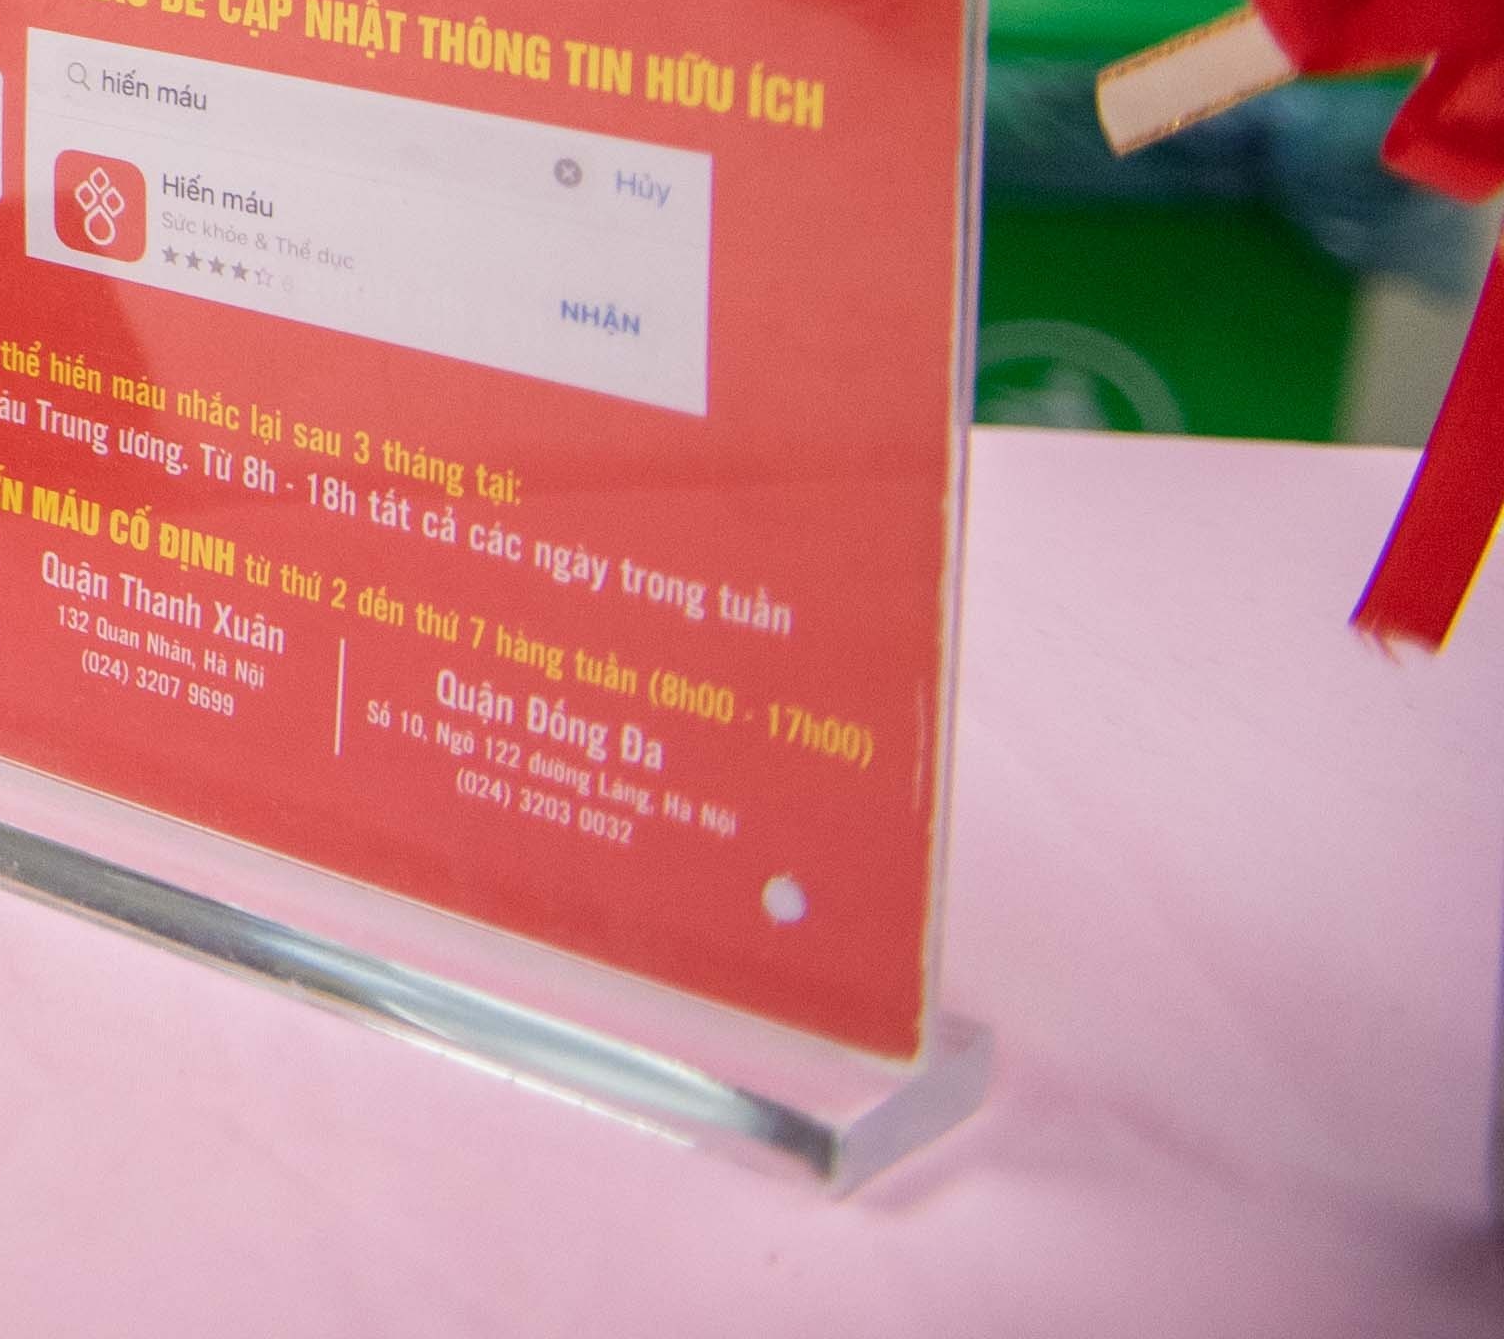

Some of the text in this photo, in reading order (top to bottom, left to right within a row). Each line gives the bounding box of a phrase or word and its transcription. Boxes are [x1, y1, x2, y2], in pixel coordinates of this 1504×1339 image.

[100, 68, 208, 113] hiến máu
[417, 14, 553, 82] THÔNG
[563, 38, 634, 97] TIN
[747, 60, 827, 131] ÍCH
[162, 173, 273, 219] Hiến máu
[559, 298, 642, 338] NHẬN
[0, 339, 42, 379] thể
[49, 351, 102, 396] hiến
[111, 370, 166, 414] máu
[176, 388, 241, 434] nhắc
[249, 403, 281, 445] lại
[292, 419, 341, 458] sau
[353, 429, 371, 464] 3
[381, 439, 464, 498] tháng
[475, 464, 523, 507] tại:
[199, 442, 233, 483] Từ
[242, 454, 276, 495] 8h
[421, 507, 458, 545] cả
[534, 539, 609, 594] ngày
[621, 559, 707, 623] trong
[719, 581, 793, 635] tuần
[41, 552, 286, 655] Quận Thanh Xuân
[245, 553, 271, 587] từ
[280, 562, 321, 603] thứ
[331, 578, 346, 610] 2
[415, 602, 459, 642] thứ
[471, 616, 486, 649] 7
[57, 604, 266, 692] 132 Quan Hà Nội
[81, 649, 235, 717] (024) 3207 9699
[435, 668, 664, 772] Quận Đống Đa
[455, 768, 635, 846] (024) 3203 0032
